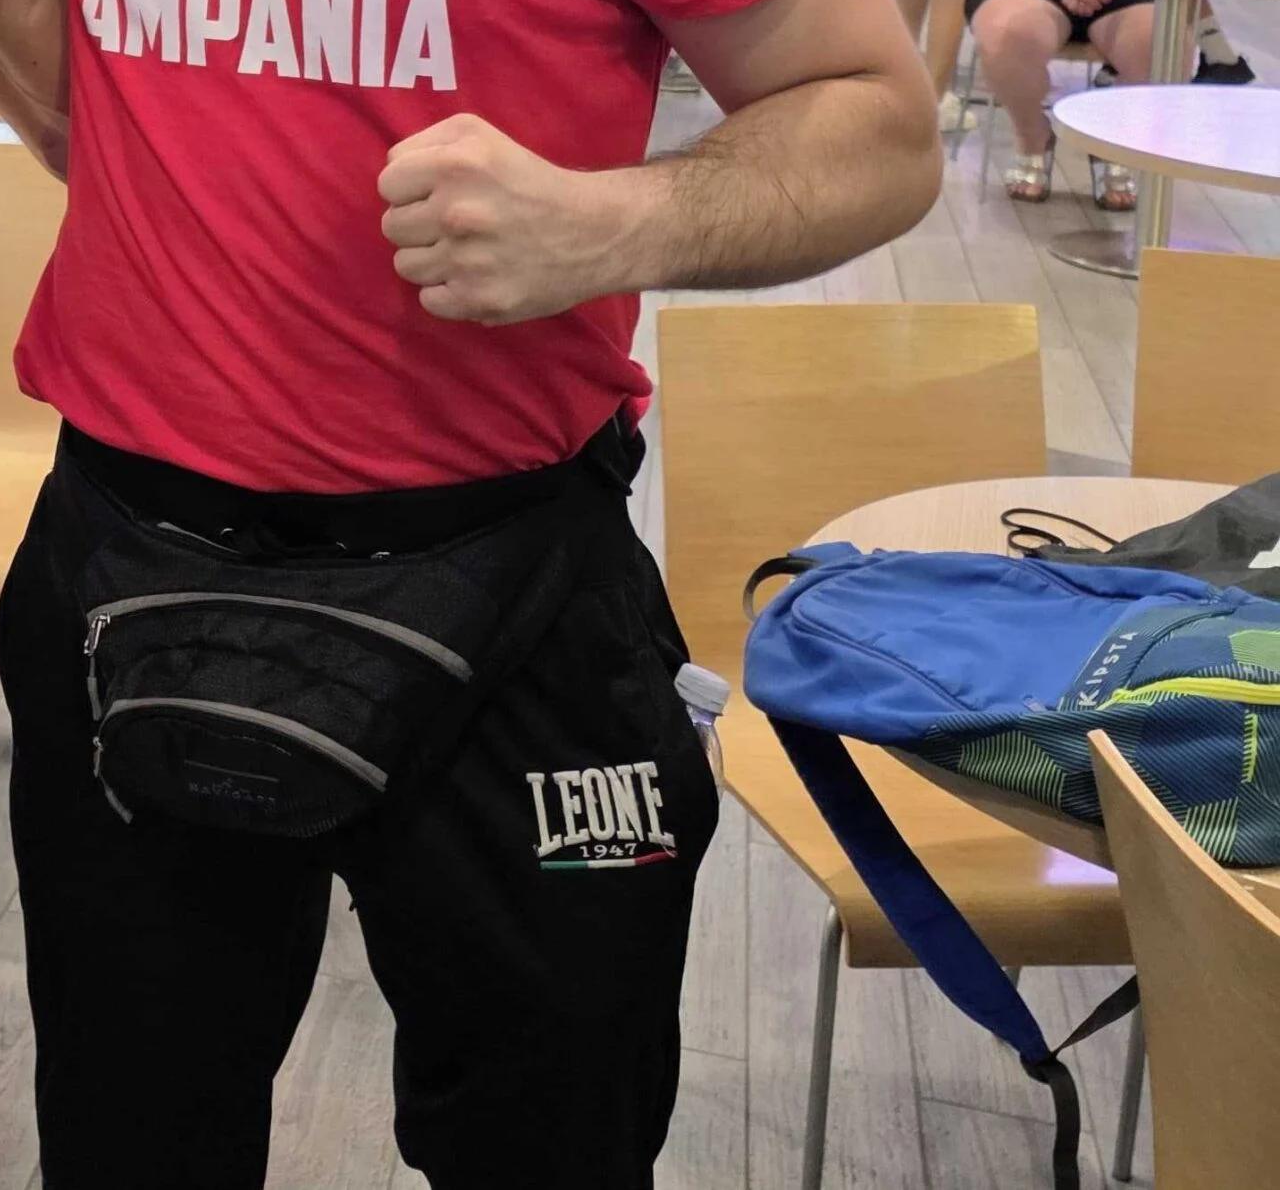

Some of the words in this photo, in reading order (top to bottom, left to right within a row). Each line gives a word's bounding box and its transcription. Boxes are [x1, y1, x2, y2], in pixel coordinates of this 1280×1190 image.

[1078, 631, 1138, 707] KIPSTA
[526, 761, 677, 858] LEONE
[580, 842, 637, 859] 1947
